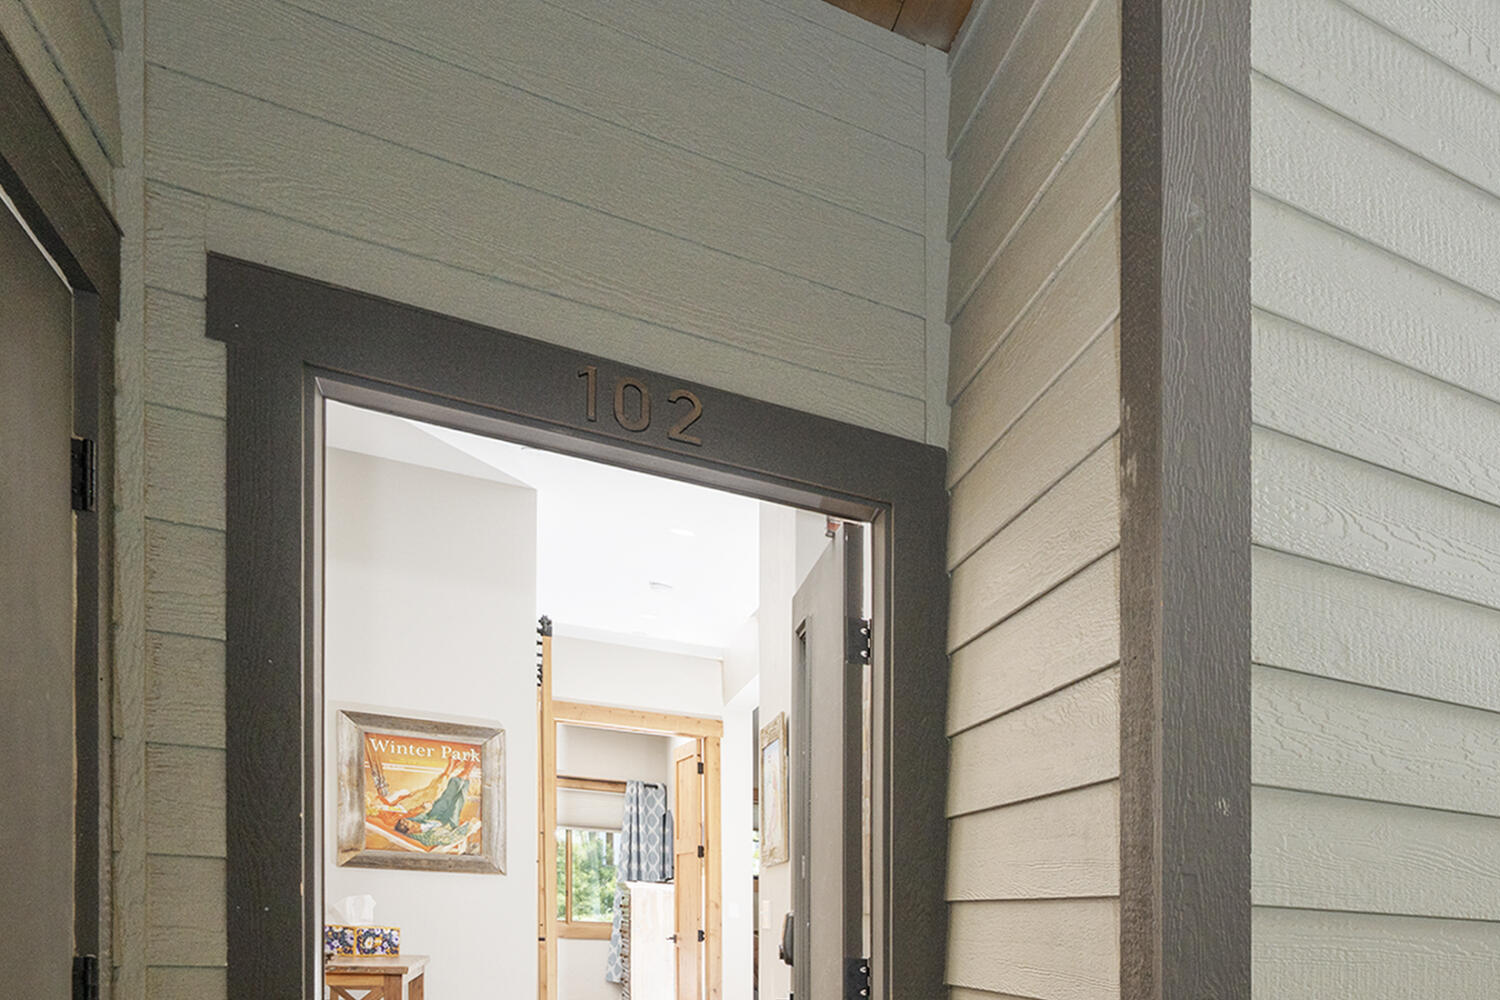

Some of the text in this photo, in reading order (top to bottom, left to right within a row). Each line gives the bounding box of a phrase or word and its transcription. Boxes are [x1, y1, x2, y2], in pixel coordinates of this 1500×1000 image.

[577, 365, 702, 447] 102
[370, 738, 481, 763] Winter Park
